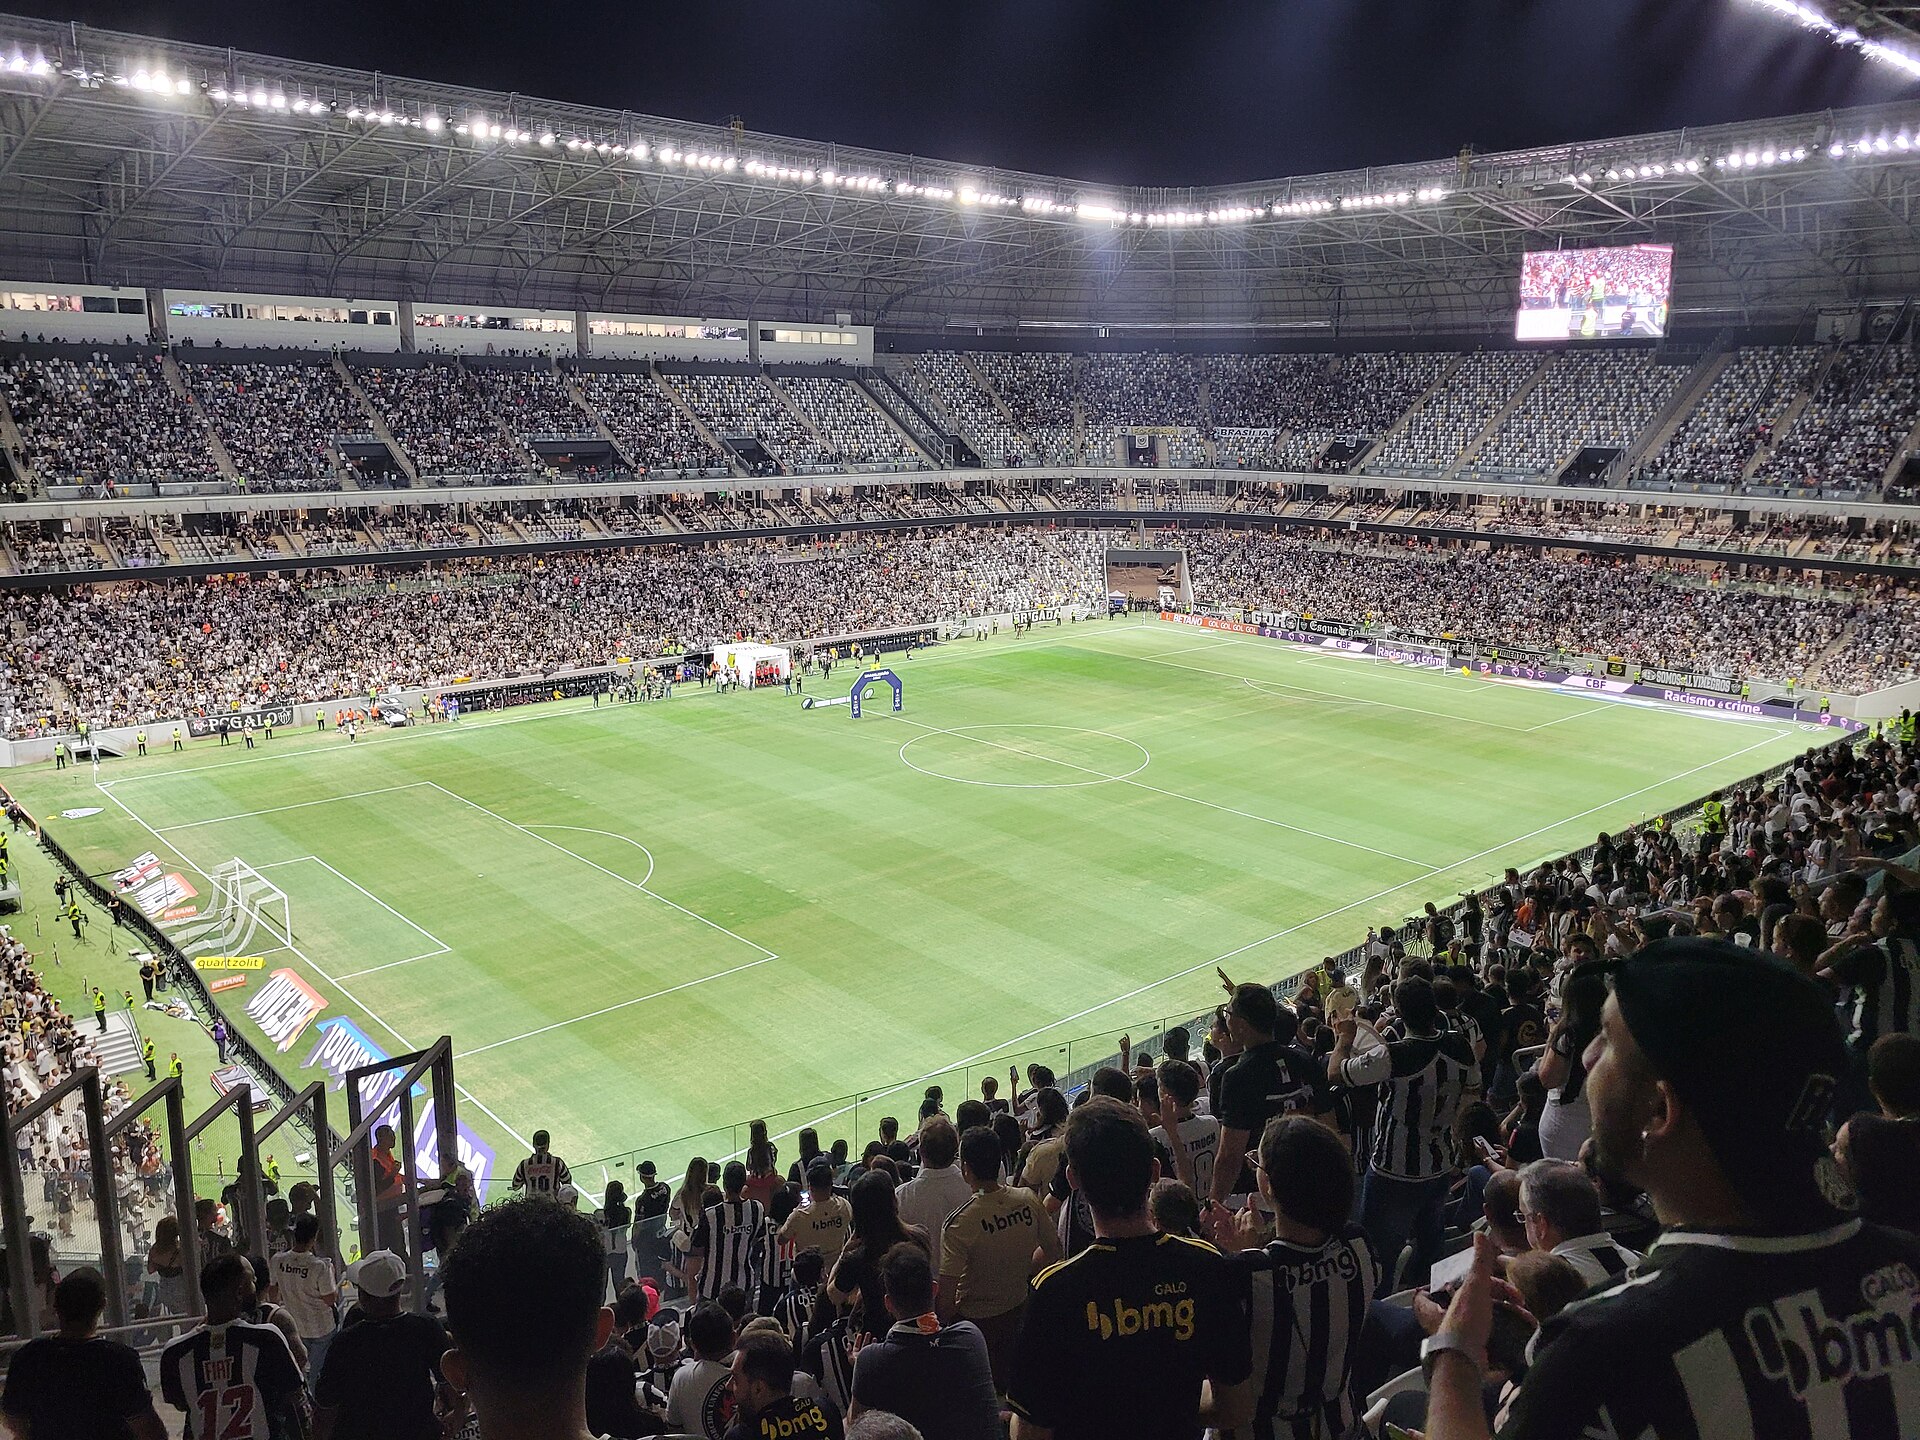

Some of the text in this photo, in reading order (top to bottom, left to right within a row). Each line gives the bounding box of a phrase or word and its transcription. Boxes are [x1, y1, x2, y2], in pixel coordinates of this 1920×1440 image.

[1173, 612, 1257, 634] BETANO GOL GOL GOL GOL
[1336, 640, 1351, 649] CBF
[1378, 647, 1415, 661] Racismo
[1586, 679, 1607, 689] CBF
[1682, 674, 1731, 692] LVINEGROS
[1664, 690, 1715, 707] Racismo
[1725, 701, 1763, 715] crime.
[164, 906, 197, 918] BETANO
[197, 958, 259, 968] quartzolit
[211, 974, 246, 990] BETANO
[820, 1217, 843, 1229] bmg
[993, 1206, 1032, 1231] bmg
[731, 1225, 752, 1234] bmg
[285, 1263, 308, 1278] bmg
[1299, 1249, 1357, 1285] bmg
[1154, 1282, 1187, 1295] GALO
[1115, 1298, 1196, 1341] bmg
[1799, 1302, 1920, 1383] bm
[203, 1357, 233, 1382] FIAT
[196, 1385, 255, 1440] 12
[776, 1406, 828, 1438] bmg
